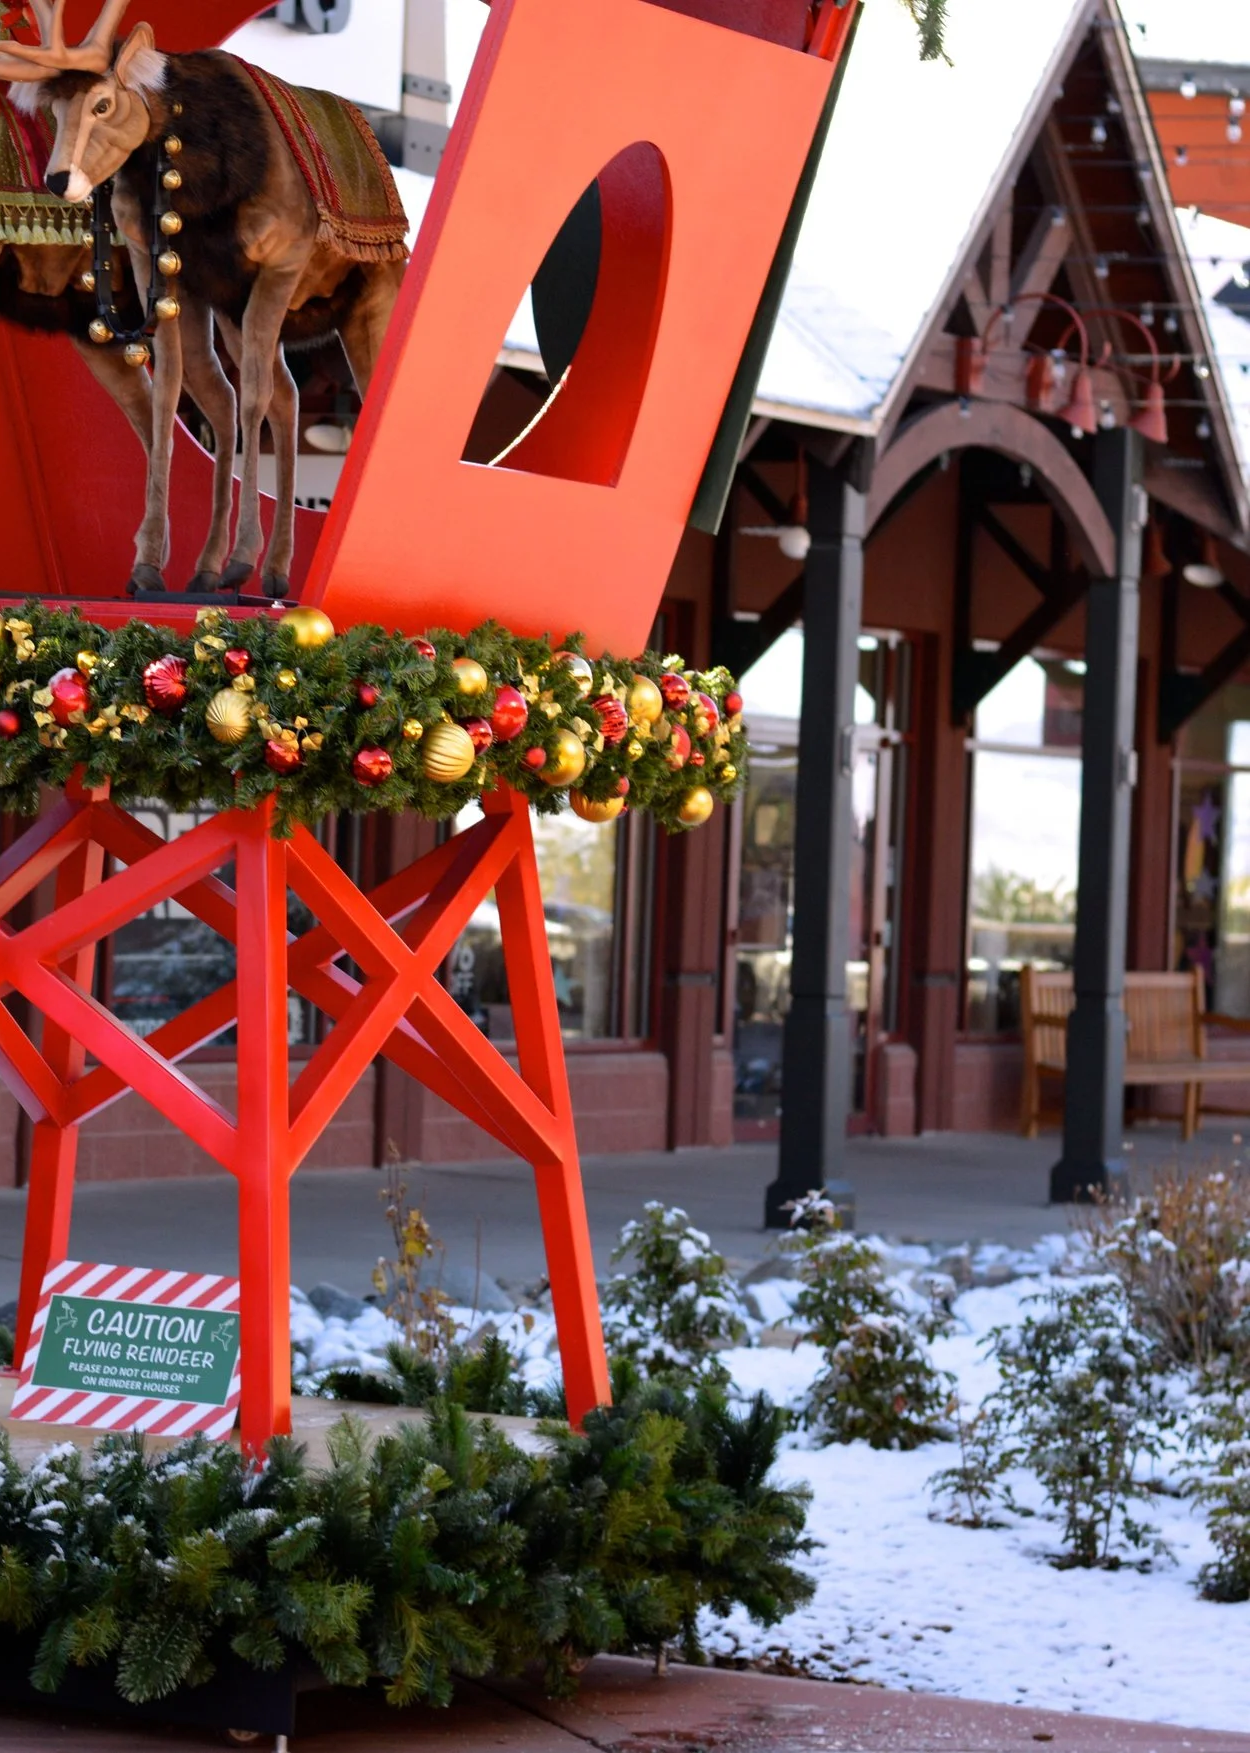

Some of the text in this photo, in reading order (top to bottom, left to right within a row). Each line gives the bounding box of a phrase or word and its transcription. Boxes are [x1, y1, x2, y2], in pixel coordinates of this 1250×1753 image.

[87, 1308, 206, 1344] CAUTION
[62, 1338, 215, 1369] FLYING REINDEER
[68, 1362, 201, 1385] PLEASE DO NOT CLIMB OR SIT
[82, 1375, 181, 1395] ON REINDEER HOUSES
